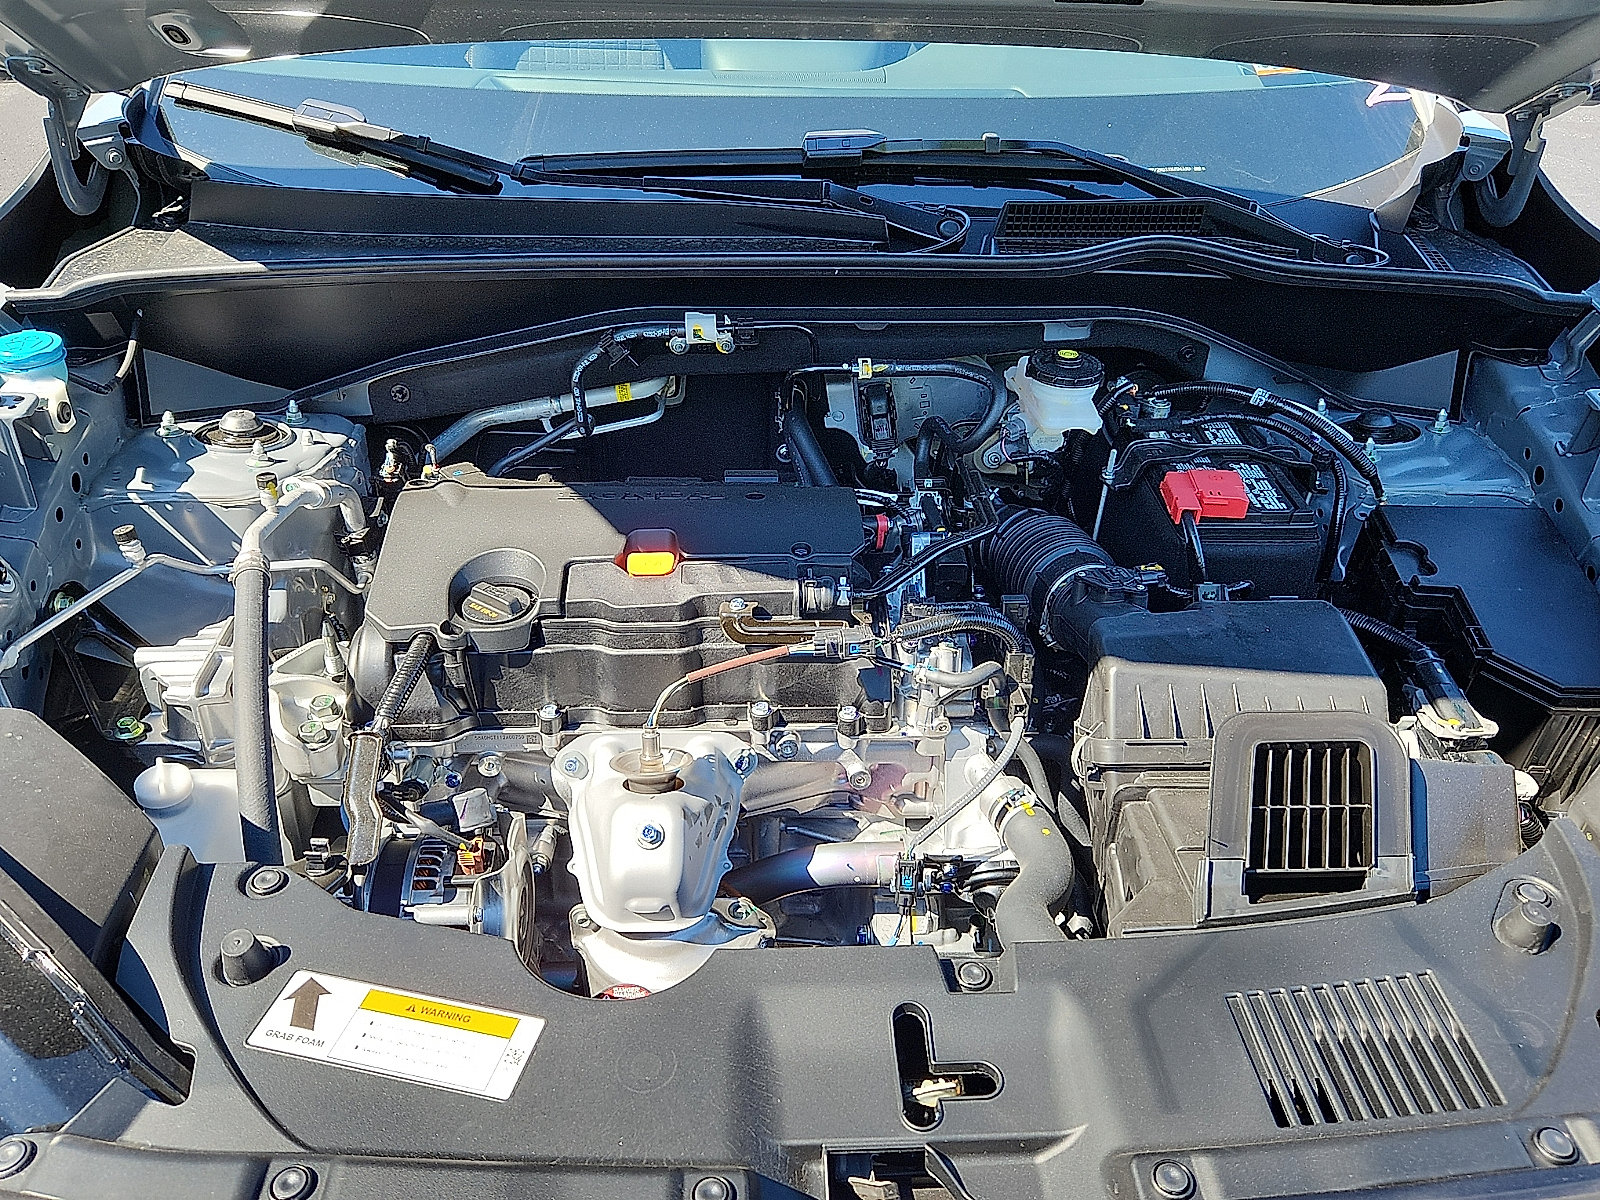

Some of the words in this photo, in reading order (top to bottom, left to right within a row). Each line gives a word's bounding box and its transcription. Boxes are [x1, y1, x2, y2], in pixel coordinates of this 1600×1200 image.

[420, 1006, 472, 1023] WARNING
[265, 1029, 295, 1041] GRAB
[295, 1035, 325, 1048] FOAM
